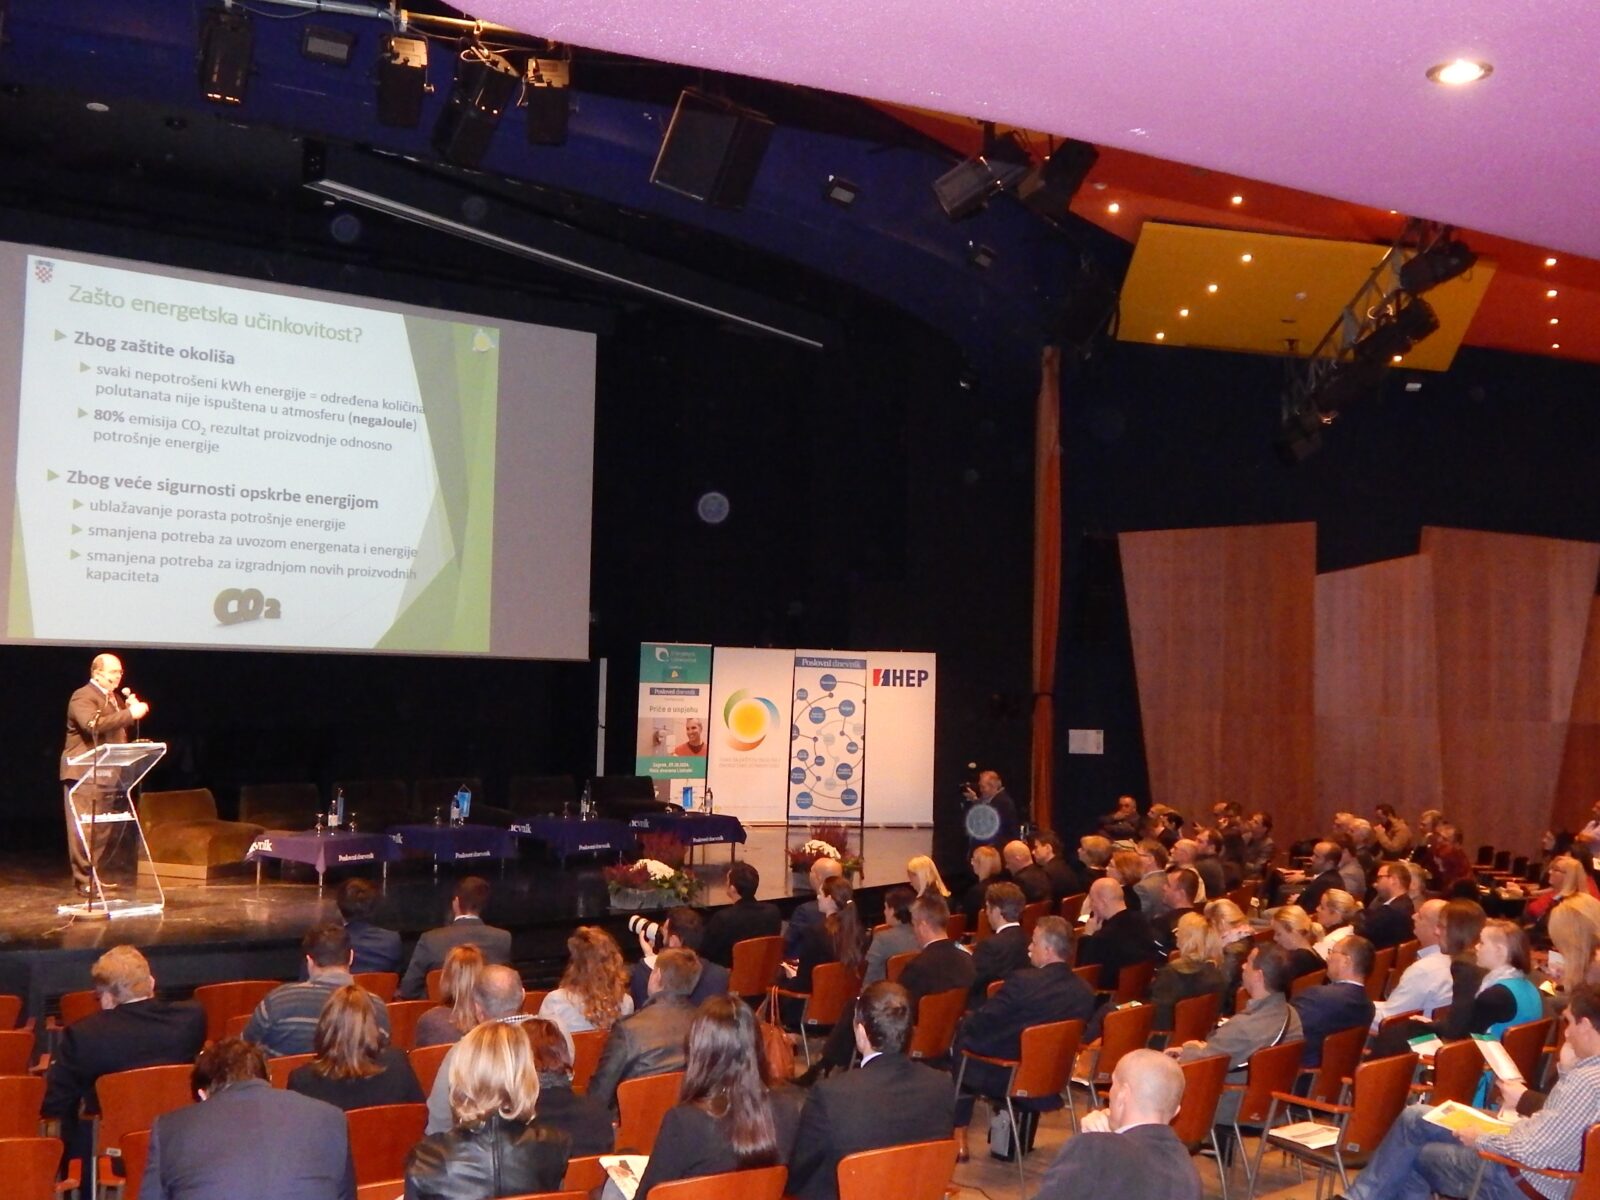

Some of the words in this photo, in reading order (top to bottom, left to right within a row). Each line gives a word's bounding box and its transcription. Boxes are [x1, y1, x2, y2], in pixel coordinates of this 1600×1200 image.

[68, 284, 125, 309] Zašto
[130, 298, 239, 326] energetska
[244, 312, 363, 344] učinkovitost?
[73, 331, 116, 352] Zbog
[120, 338, 175, 357] zaštite
[179, 346, 235, 365] okoliša
[96, 364, 131, 379] svaki
[135, 369, 217, 390] nepotrošeni
[221, 378, 251, 394] kWh
[255, 384, 306, 402] energije
[320, 392, 379, 409] određena
[382, 399, 425, 415] količina
[95, 383, 172, 403] polutanata
[175, 393, 201, 407] nije
[204, 395, 266, 414] ispuštena
[270, 404, 278, 415] u
[281, 406, 345, 423] atmosferu
[348, 411, 417, 432] (negaJoule)
[93, 429, 161, 449] potrošnje
[165, 438, 220, 455] energije
[94, 409, 125, 424] 80%
[128, 413, 178, 430] emisija
[210, 422, 260, 438] rezultat
[263, 428, 337, 448] proizvodnje
[340, 436, 393, 452] odnosno
[66, 470, 110, 490] Zbog
[114, 475, 152, 491] veće
[156, 478, 236, 498] sigurnosti
[240, 487, 302, 503] opskrbe
[305, 493, 379, 511] energijom
[89, 500, 173, 520] ublažavanje
[176, 508, 227, 522] porasta
[230, 512, 293, 528] potrošnje
[295, 517, 346, 532] energije
[88, 525, 157, 541] smanjena
[161, 531, 215, 544] potreba
[218, 536, 233, 546] za
[236, 536, 287, 549] uvozom
[290, 541, 360, 555] energenata
[370, 546, 418, 560] energije
[86, 551, 156, 566] smanjena
[159, 555, 214, 569] potreba
[217, 560, 231, 569] za
[235, 558, 307, 575] izgradnjom
[310, 563, 344, 576] novih
[347, 567, 417, 581] proizvodnih
[86, 567, 160, 584] kapaciteta
[801, 658, 832, 667] Poslovni
[892, 669, 929, 687] HEP
